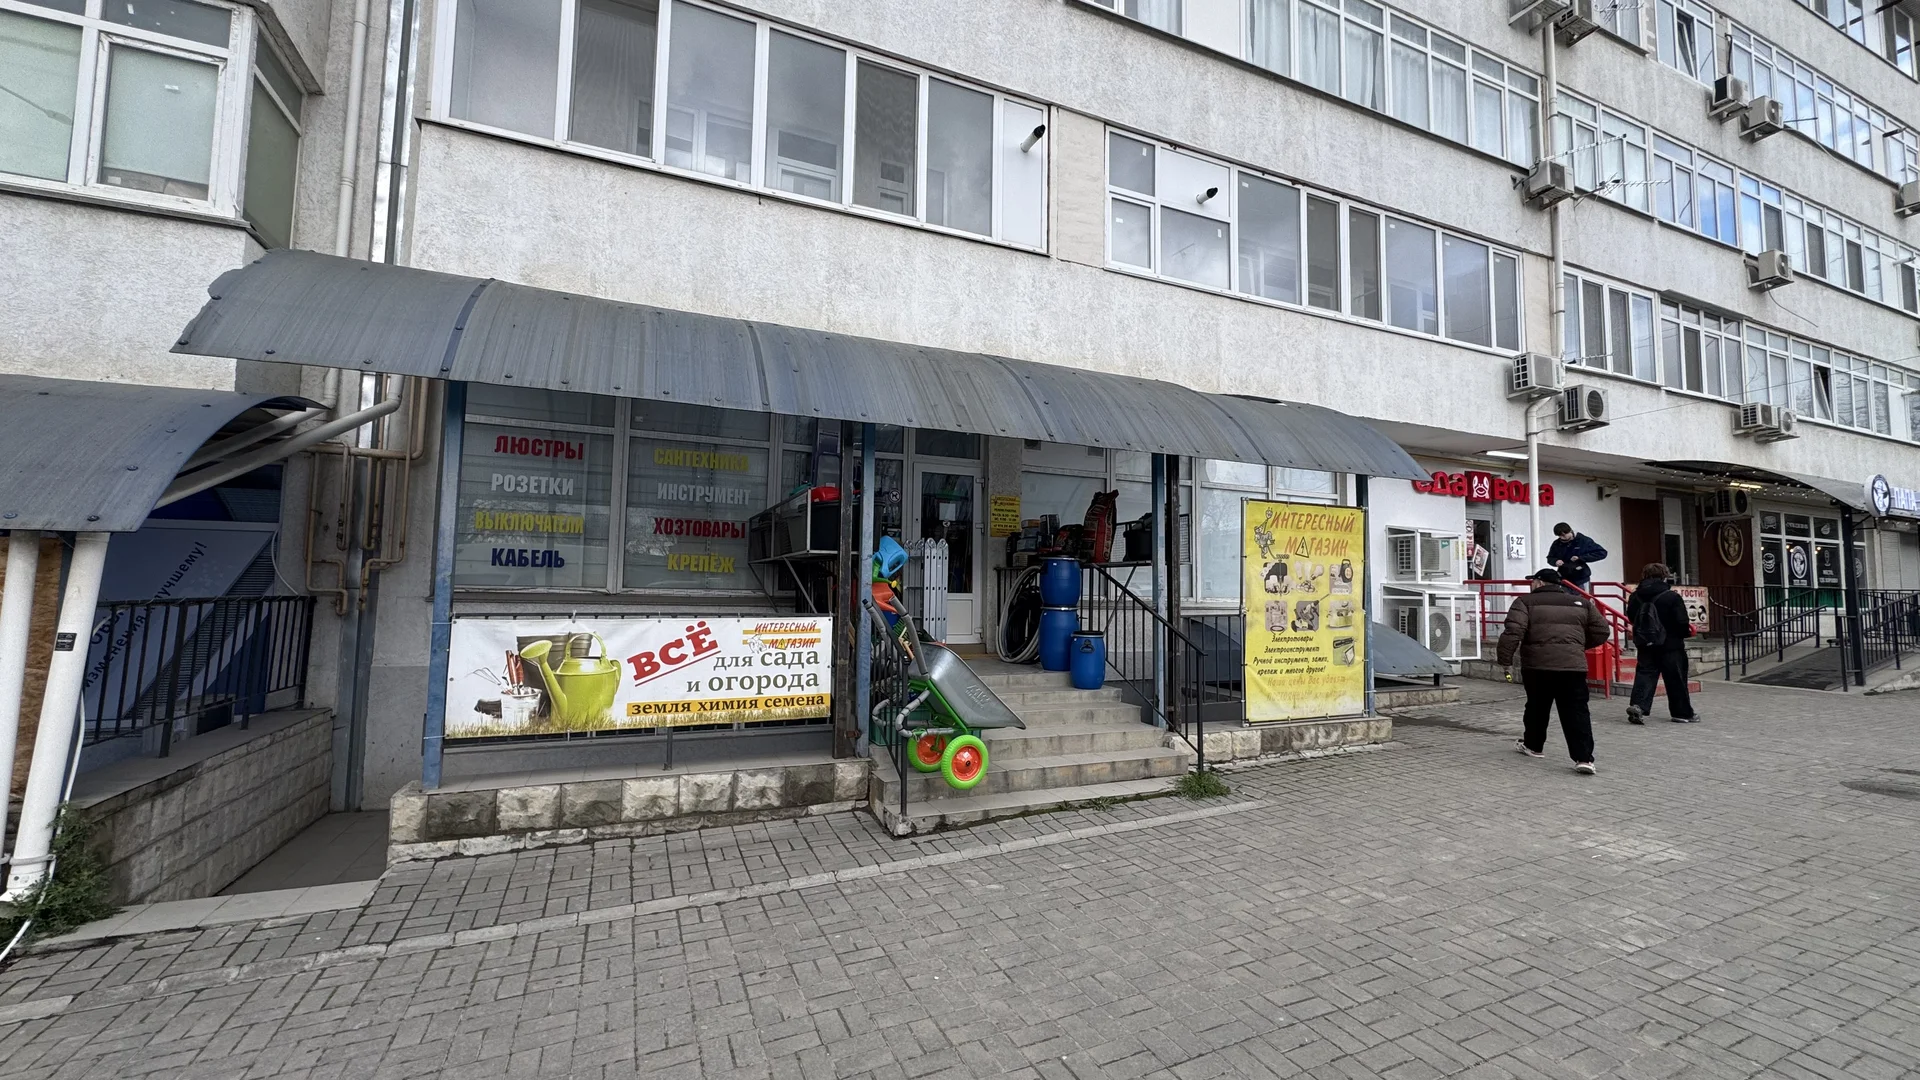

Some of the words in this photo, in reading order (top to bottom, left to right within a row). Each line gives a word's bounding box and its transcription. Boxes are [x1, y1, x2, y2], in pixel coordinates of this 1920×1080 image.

[494, 435, 584, 460] ЛЮСТРЫ
[653, 448, 750, 471] САНТЕХНИКА
[490, 473, 574, 496] РОЗЕТКИ
[657, 482, 751, 505] ИНСТРУМЕНТ
[474, 511, 585, 534] ВЫКЛЮЧАТЕЛИ
[653, 517, 746, 539] ХОЗТОВАРЫ
[1270, 511, 1356, 533] ИНТЕРЕСНЫЙ
[491, 548, 565, 568] КАБЕЛЬ
[667, 552, 736, 573] КРЕПЁЖ
[754, 620, 817, 633] ИНТЕРЕСНЫЙ
[627, 620, 719, 681] ВСЁ
[1264, 645, 1320, 654] Электроинструмент
[1272, 635, 1313, 644] Электротовары
[713, 656, 753, 671] для
[760, 650, 820, 669] сада
[686, 680, 700, 692] и
[708, 672, 819, 695] огорода
[631, 702, 691, 715] земля
[697, 698, 758, 711] химия
[764, 693, 825, 708] семена
